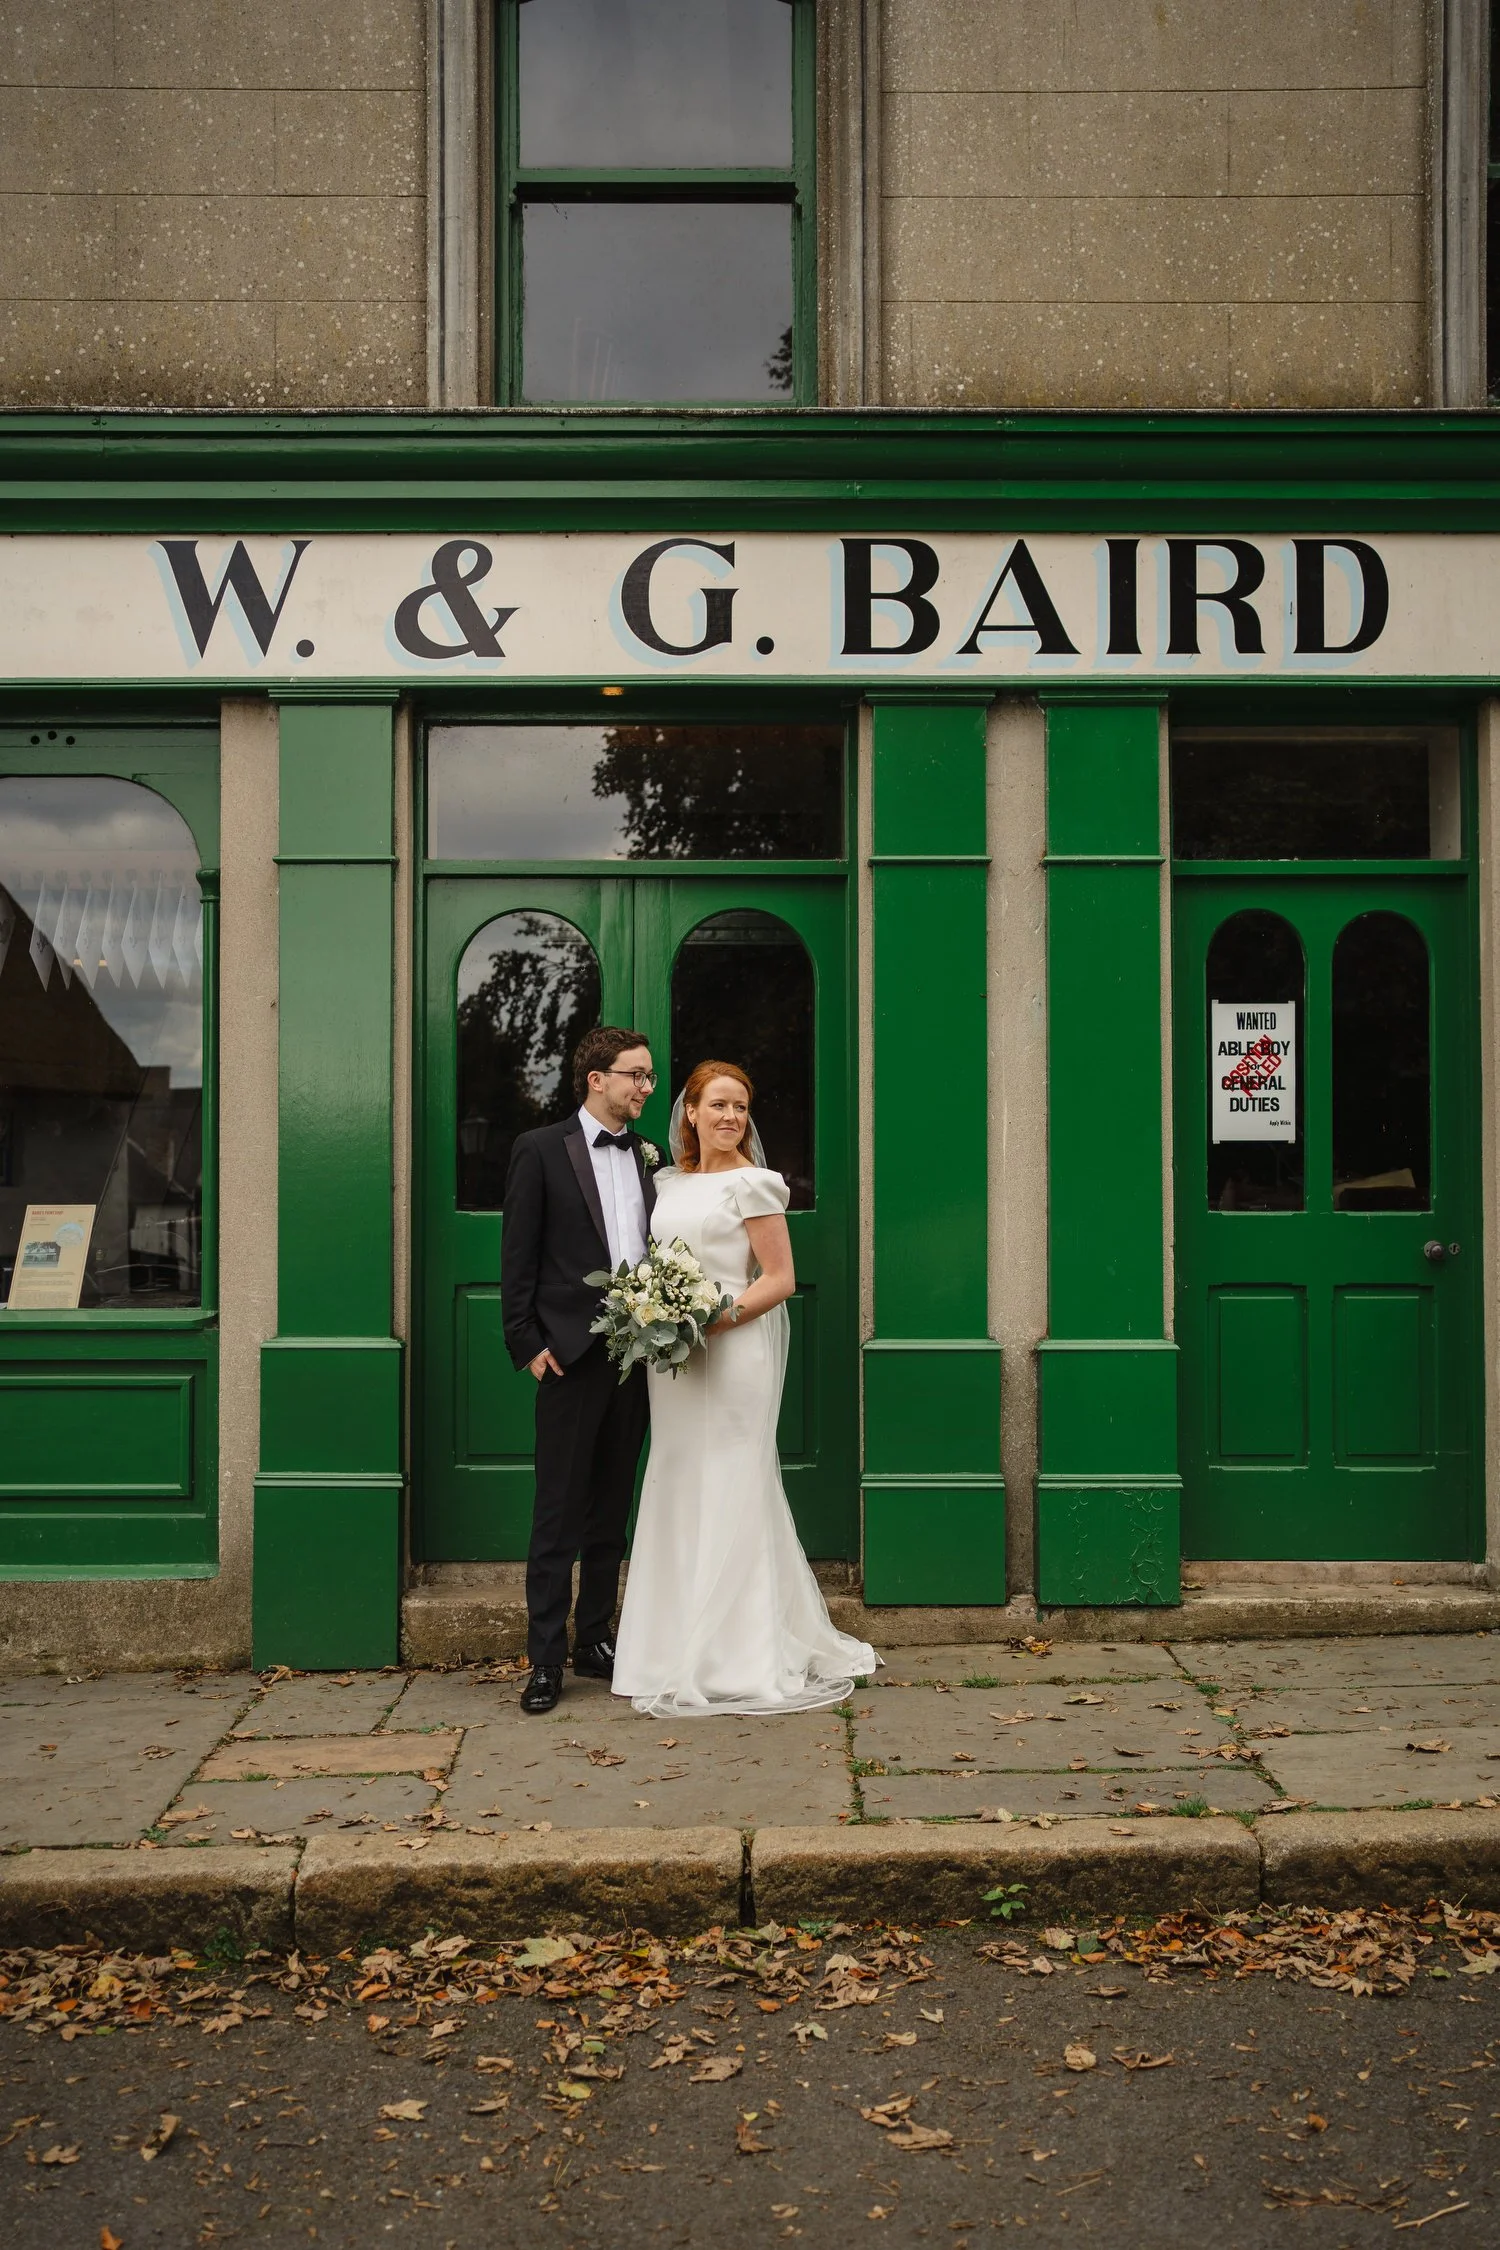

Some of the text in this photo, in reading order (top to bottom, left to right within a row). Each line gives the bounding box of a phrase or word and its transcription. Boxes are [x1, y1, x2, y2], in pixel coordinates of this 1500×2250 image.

[157, 537, 1389, 659] W. & G. BAIRD
[1236, 1011, 1277, 1030] WANTED
[1218, 1041, 1256, 1056] ABLE
[1221, 1075, 1287, 1091] GENERAL
[1230, 1097, 1280, 1112] DUTIES
